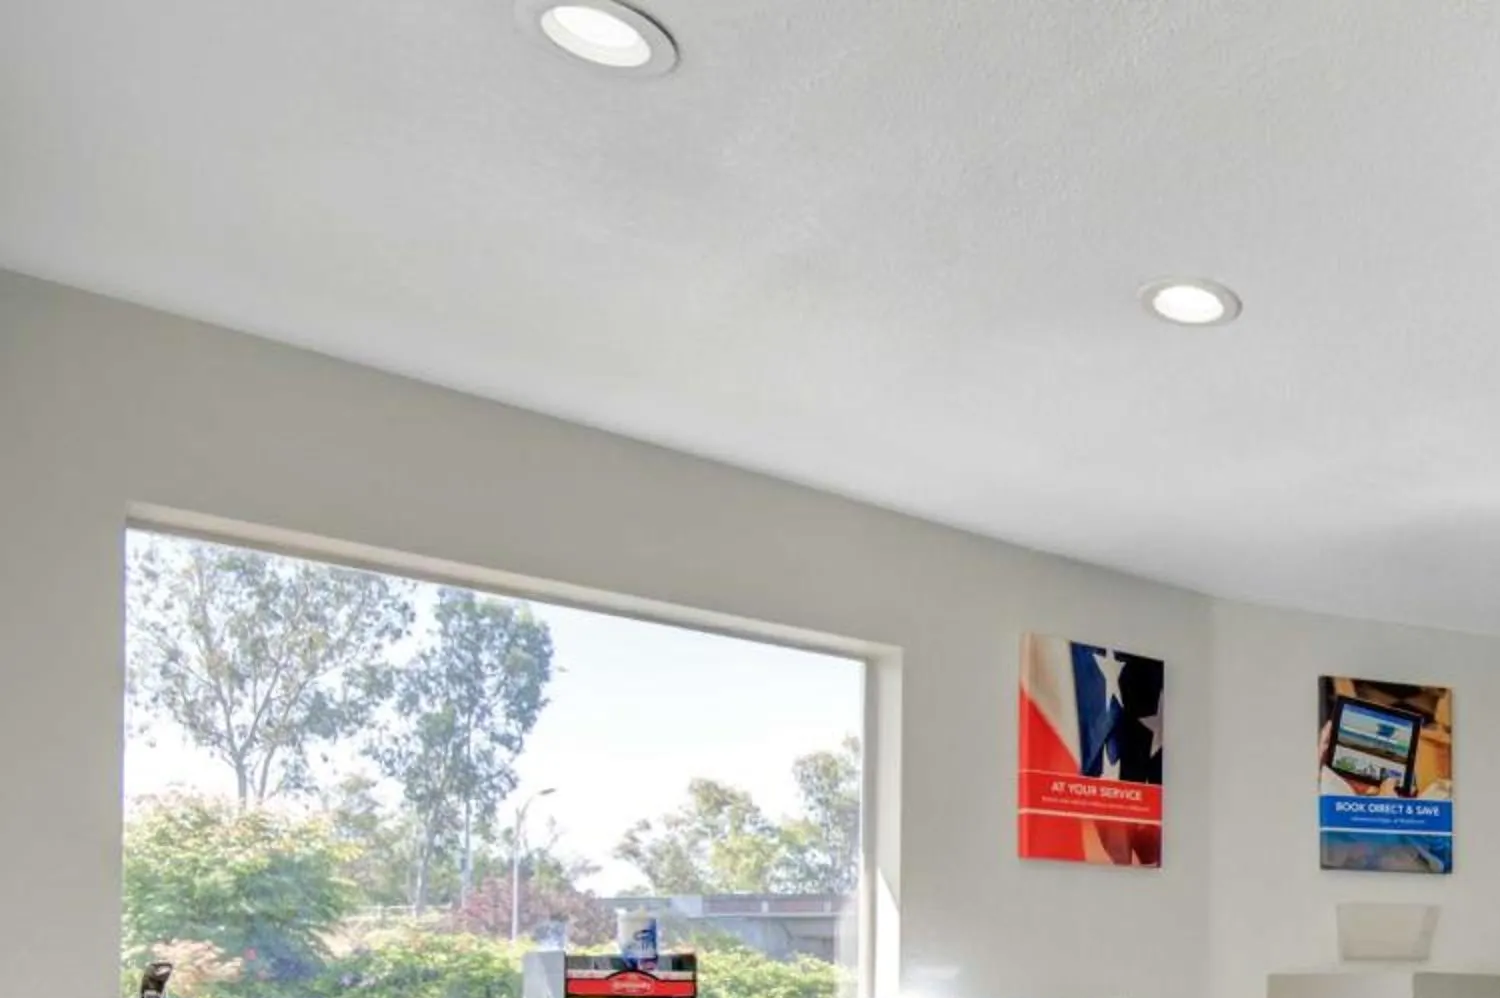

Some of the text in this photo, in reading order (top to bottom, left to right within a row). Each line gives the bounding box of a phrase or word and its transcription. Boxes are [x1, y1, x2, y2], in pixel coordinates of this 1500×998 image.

[1051, 781, 1142, 801] AT YOUR SERVICE
[1335, 801, 1439, 817] BOOK DIRECT & SAVE
